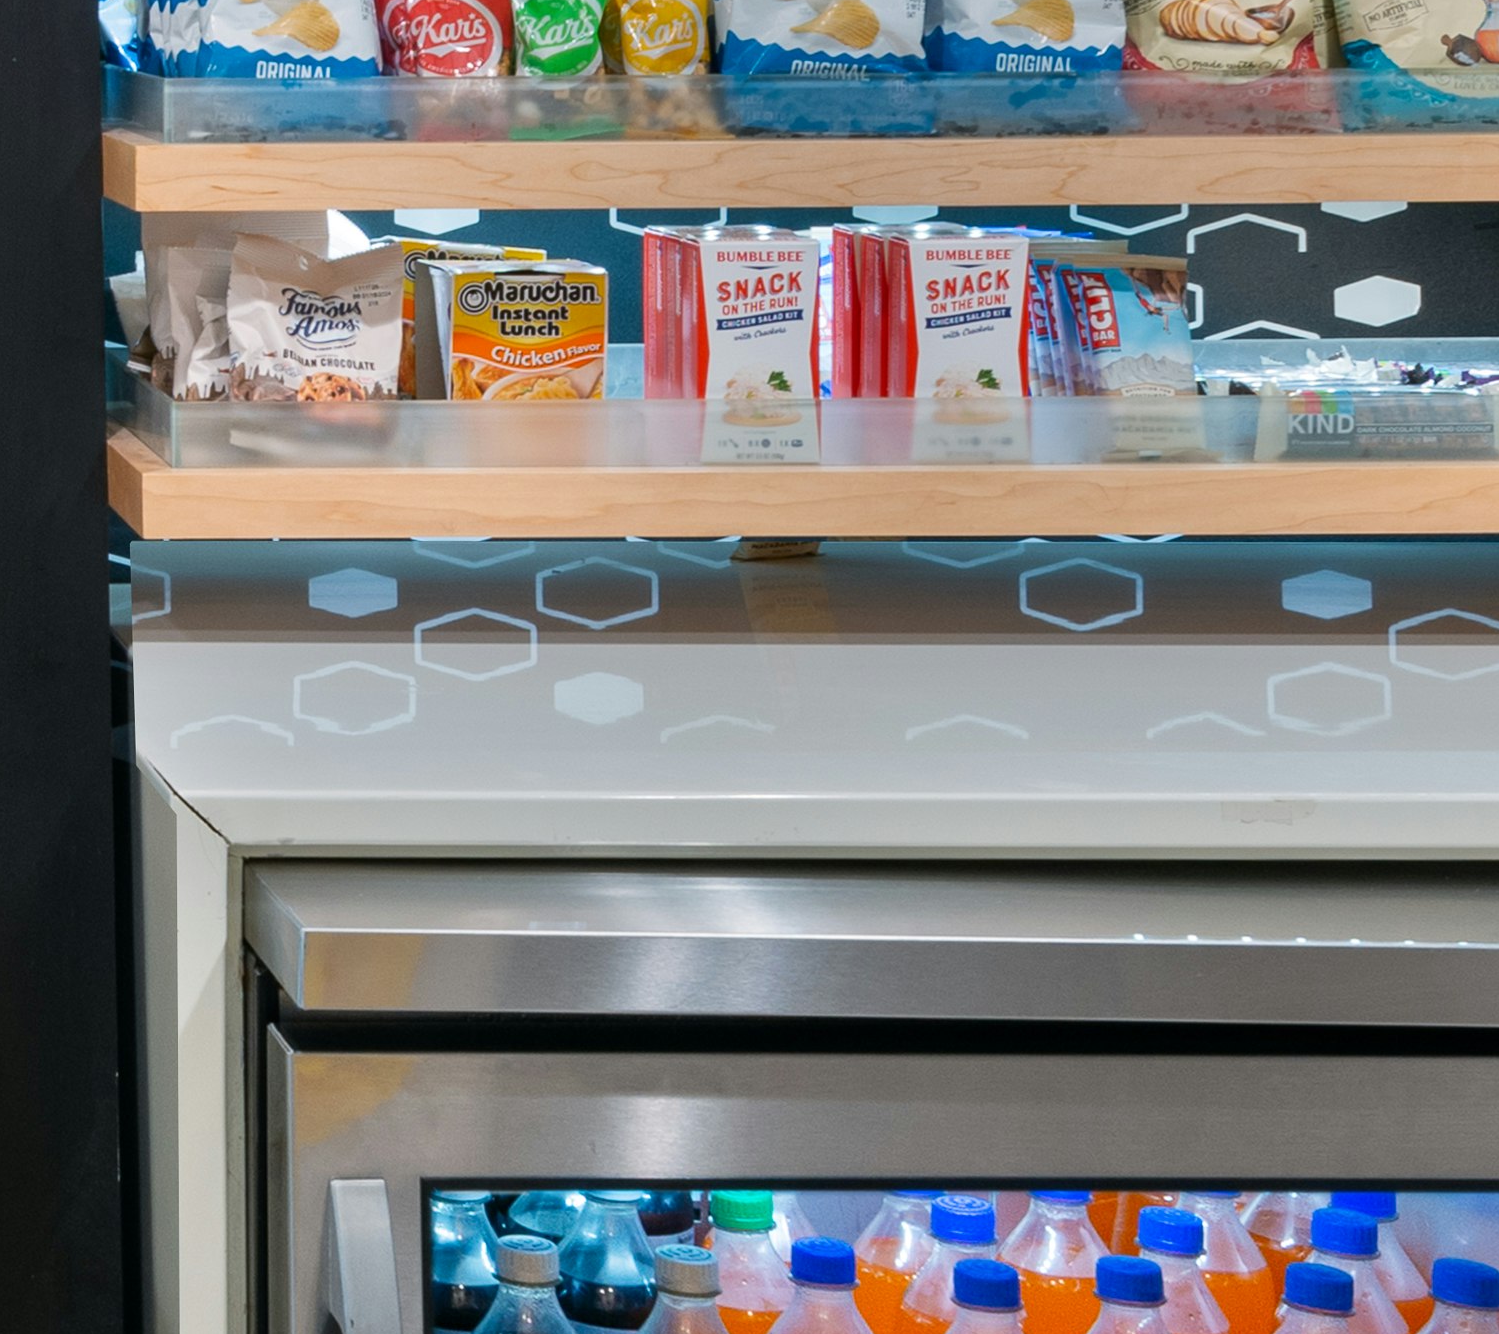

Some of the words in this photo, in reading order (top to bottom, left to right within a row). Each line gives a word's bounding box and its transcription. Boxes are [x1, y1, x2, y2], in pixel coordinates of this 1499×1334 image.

[410, 13, 486, 45] Kar's
[716, 251, 774, 262] BUMBLE
[777, 251, 804, 262] BEE
[925, 250, 981, 261] BUMBLE
[984, 250, 1013, 260] BEE
[486, 281, 595, 303] Maruchan
[717, 272, 803, 302] SNACK
[925, 269, 1011, 301] SNACK
[279, 288, 361, 318] Famous
[492, 305, 568, 321] Instant
[1085, 273, 1107, 332] CLIF
[286, 316, 355, 337] Amos
[499, 321, 560, 337] Lunch
[1093, 329, 1116, 342] BAR
[321, 359, 375, 370] CHOCOLATE
[491, 345, 566, 367] Chicken
[1288, 414, 1355, 434] KIND
